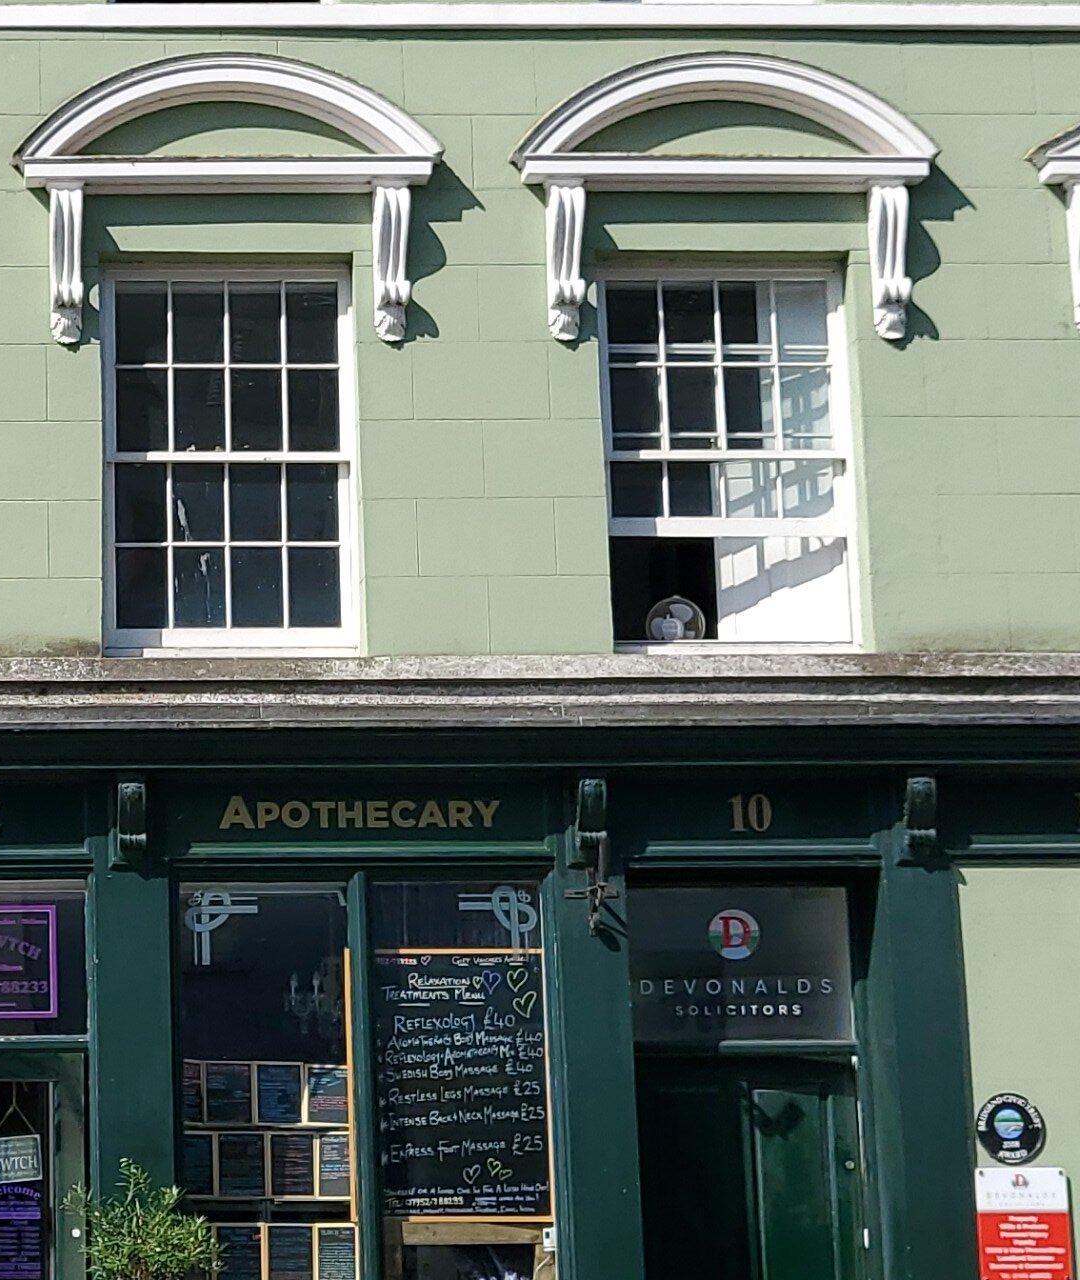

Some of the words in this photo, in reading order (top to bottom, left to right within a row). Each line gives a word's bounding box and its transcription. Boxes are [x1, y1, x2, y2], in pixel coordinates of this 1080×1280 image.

[220, 796, 500, 830] APOTHECARY
[728, 794, 772, 833] 10
[718, 915, 751, 948] D
[408, 972, 471, 989] RELAXATION
[640, 979, 834, 995] DEVONALDS
[381, 986, 450, 1002] TREATMENTS
[454, 986, 486, 1001] MENU
[394, 1013, 476, 1034] REFLEXOLOGY
[483, 1006, 516, 1030] £40
[675, 1004, 803, 1016] SOLICITORS
[516, 1028, 543, 1045] £40
[518, 1045, 544, 1060] £40
[386, 1067, 428, 1083] SWEDISH
[455, 1063, 498, 1078] MASSAGE
[505, 1059, 534, 1075] £40
[389, 1087, 438, 1105] RESTLESS
[440, 1086, 462, 1103] LEGS
[464, 1085, 509, 1103] MASSAGE
[513, 1080, 541, 1096] £25
[389, 1112, 428, 1131] INTENSE
[483, 1105, 520, 1125] MASSAGE
[520, 1102, 546, 1122] £25
[390, 1142, 435, 1163] EXPRESS
[461, 1138, 507, 1158] MASSAGE
[512, 1133, 543, 1156] £25
